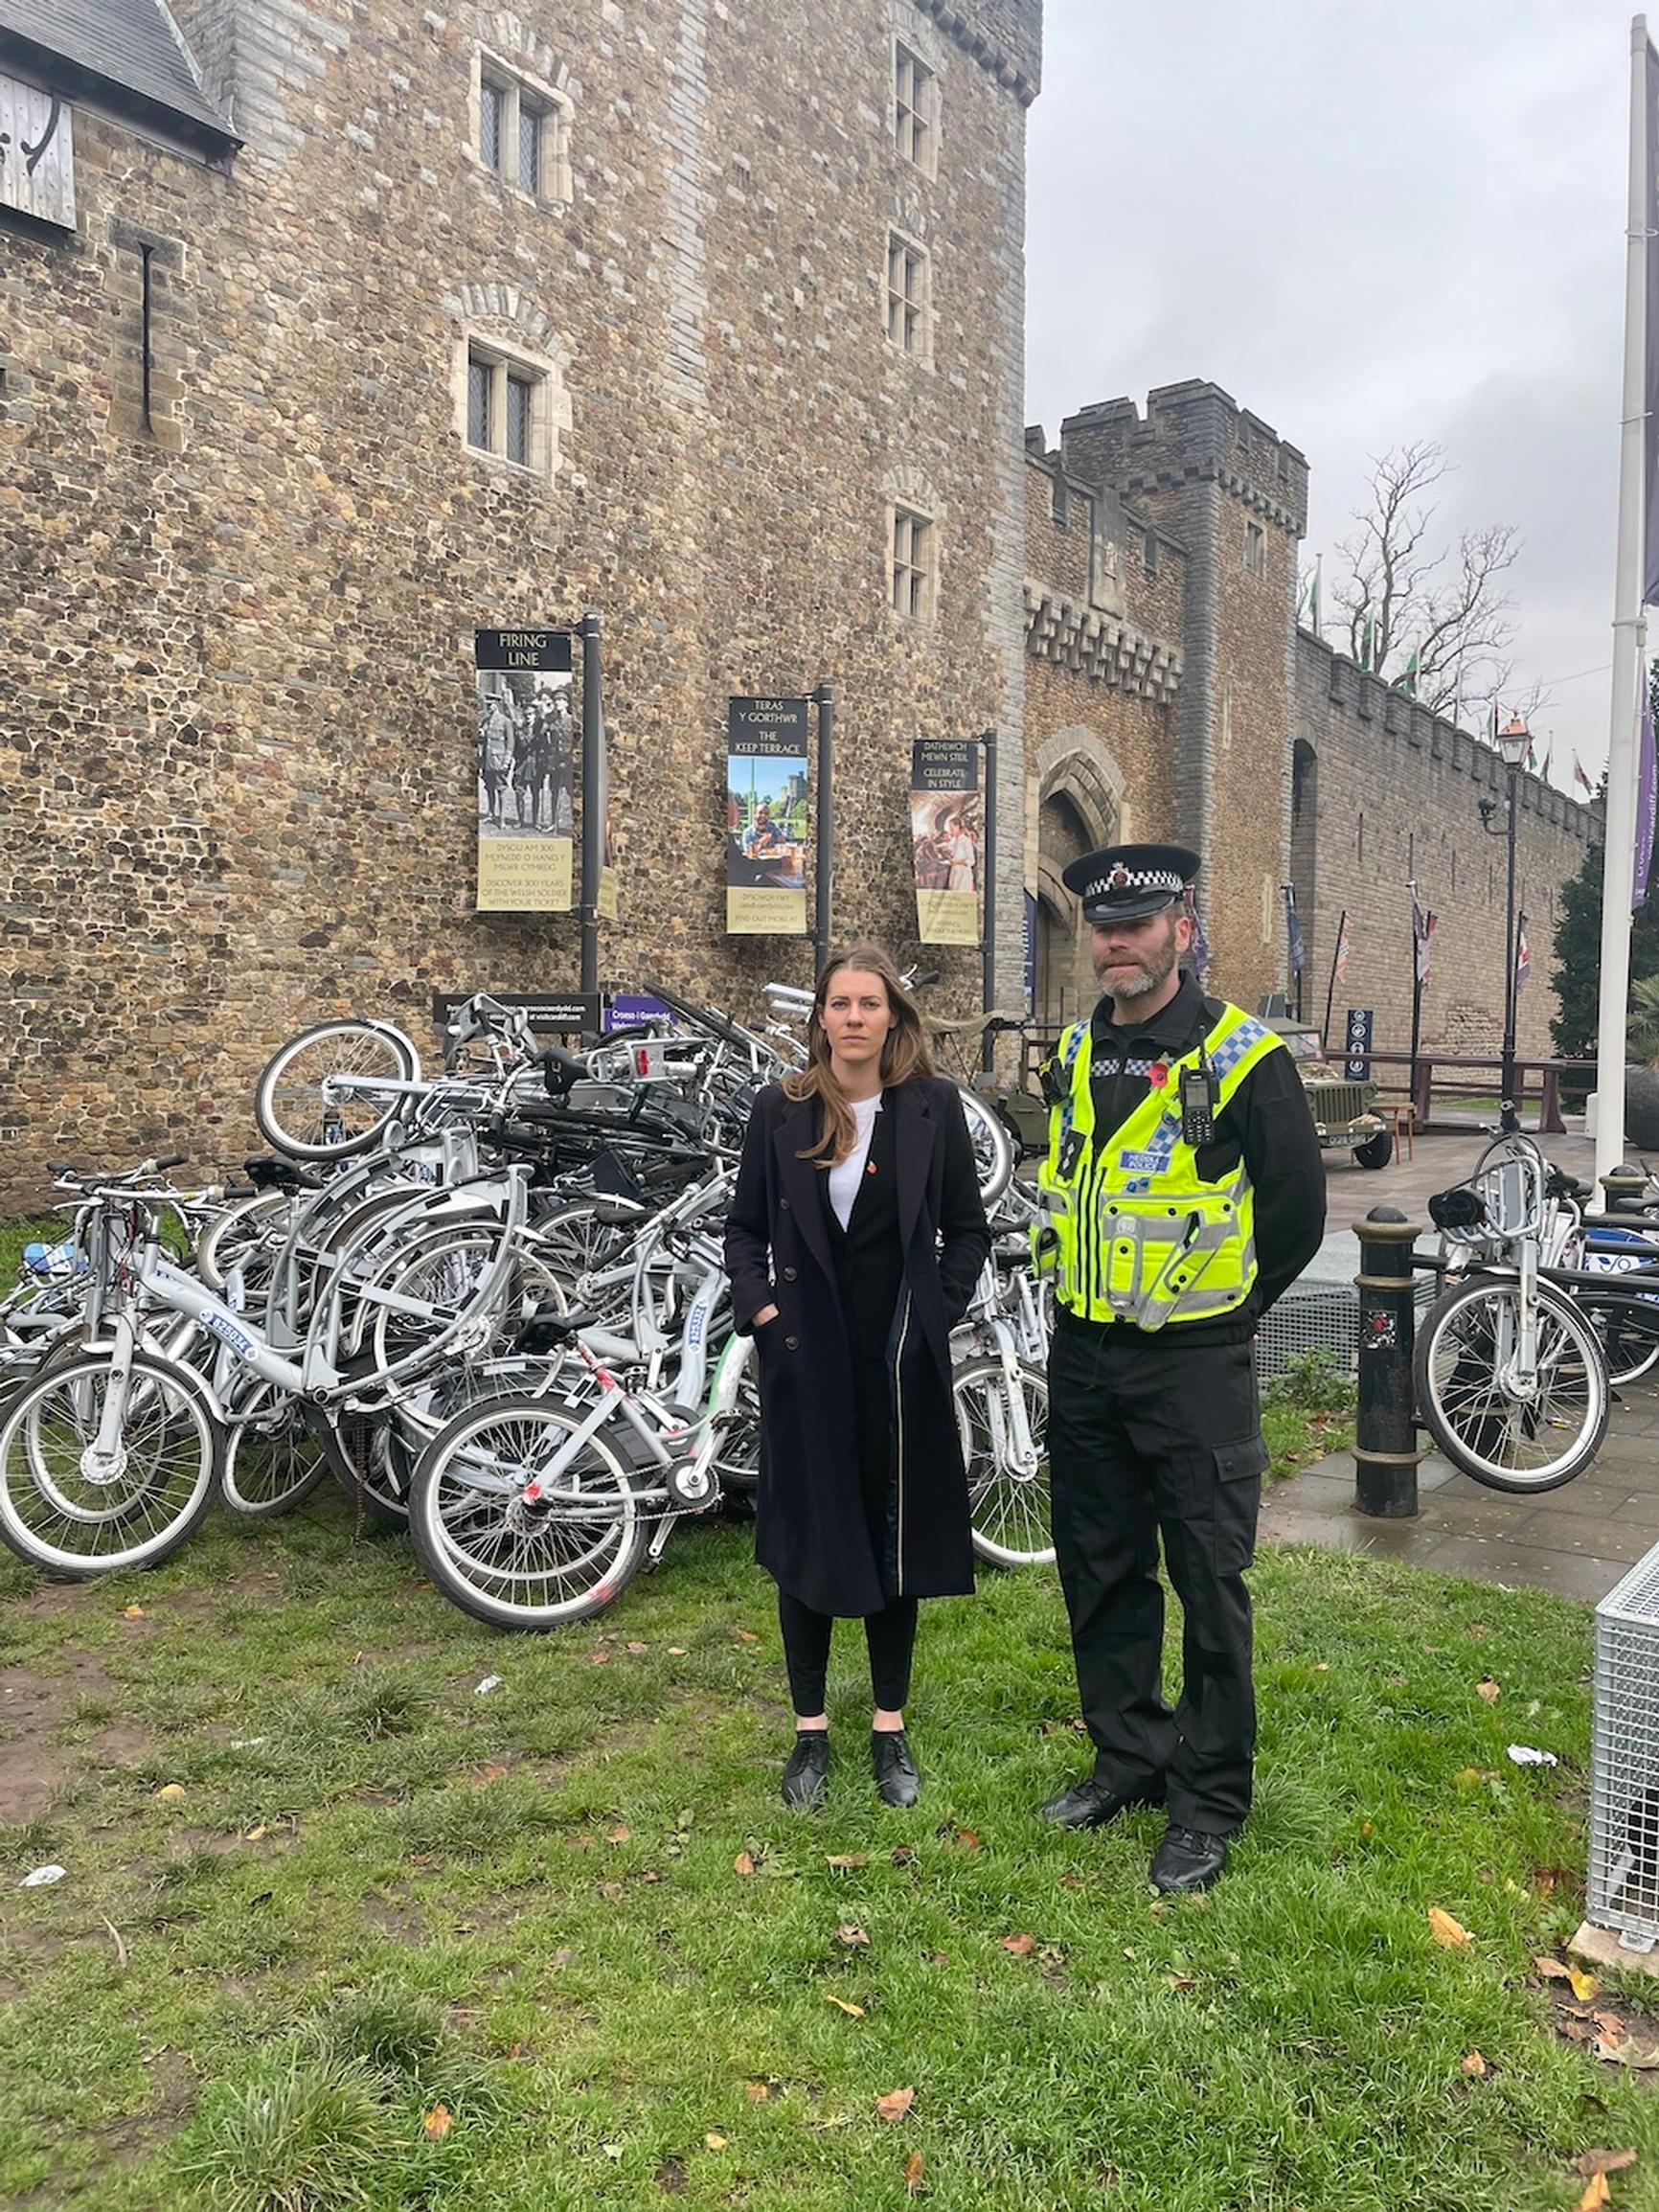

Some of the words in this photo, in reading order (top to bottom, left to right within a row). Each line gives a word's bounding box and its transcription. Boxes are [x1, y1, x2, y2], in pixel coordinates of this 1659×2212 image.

[499, 633, 548, 649] FIRING
[509, 652, 540, 666] LINE
[754, 700, 784, 711] TERAS
[739, 712, 747, 722] Y
[759, 730, 779, 741] THE
[735, 742, 759, 754] KEEP
[760, 743, 801, 755] TERRACE
[922, 767, 966, 779] CELEBRATE
[927, 779, 938, 788] IN
[939, 779, 962, 788] STYLE
